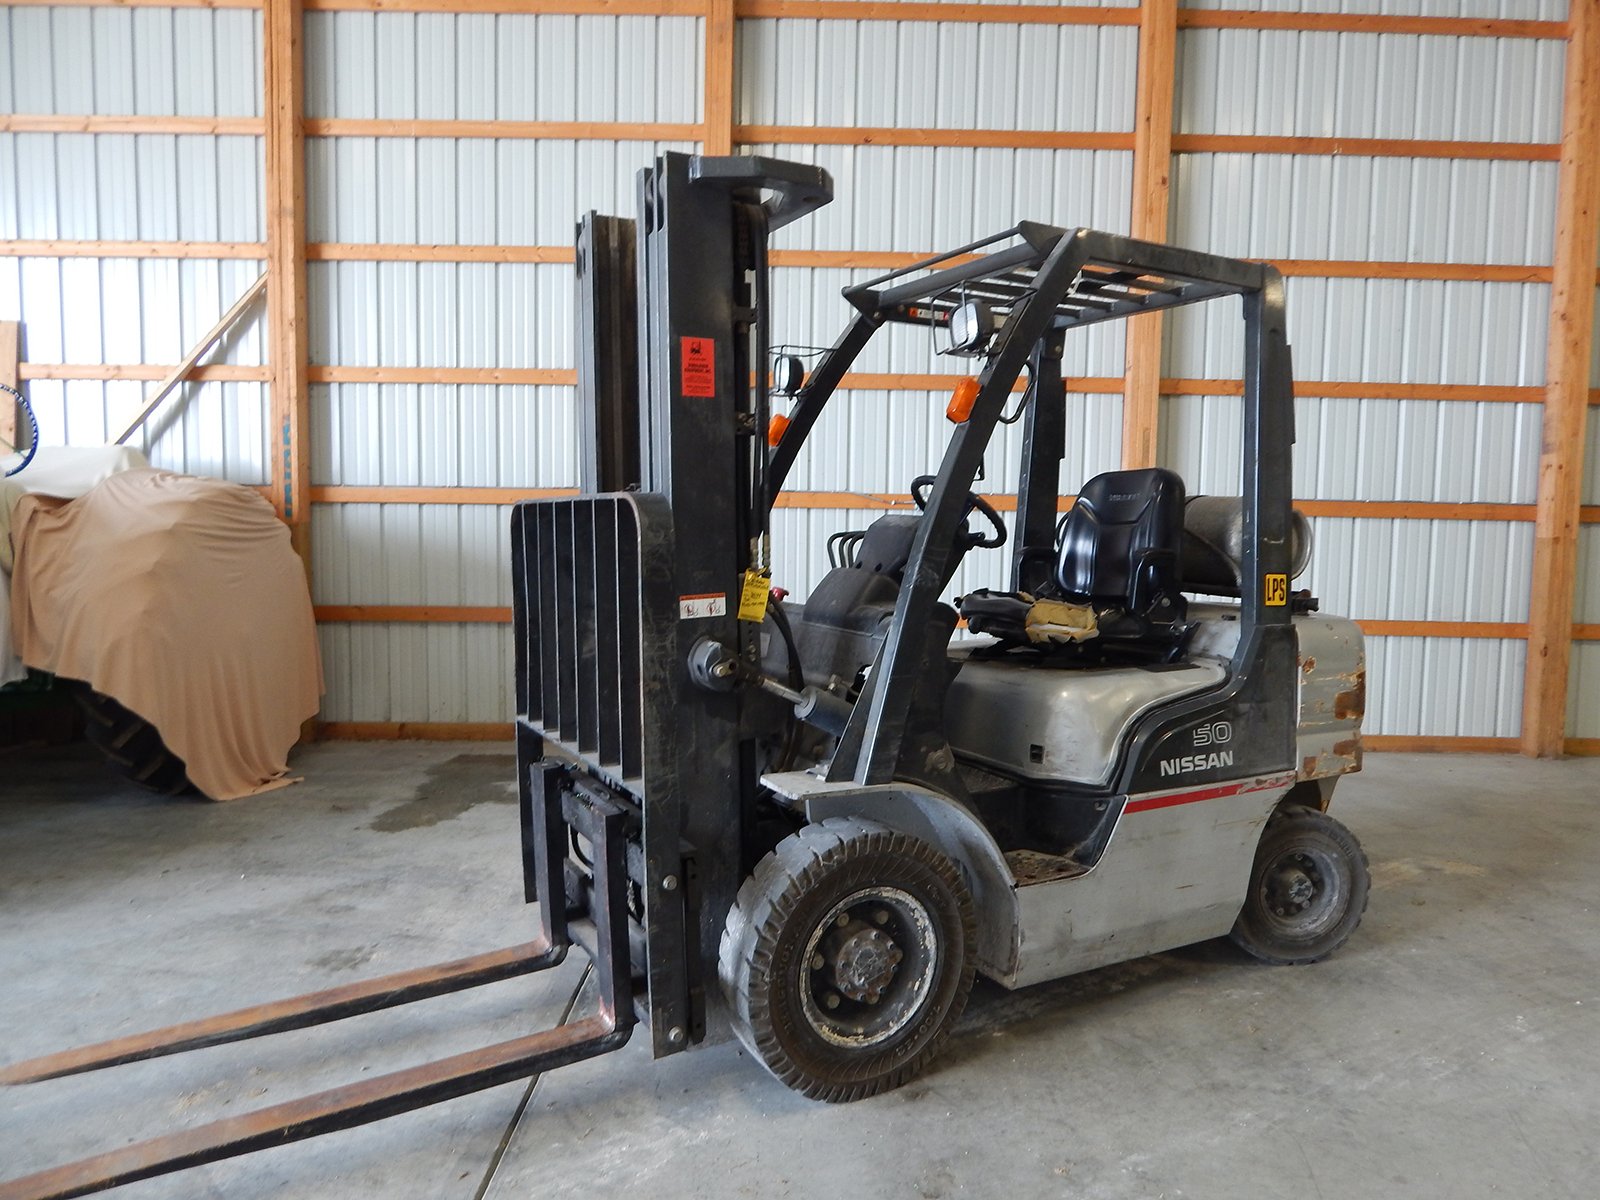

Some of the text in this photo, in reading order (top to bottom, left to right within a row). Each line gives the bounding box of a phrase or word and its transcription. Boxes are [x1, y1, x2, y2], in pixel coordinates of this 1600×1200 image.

[1267, 578, 1285, 602] LPS
[1193, 721, 1232, 747] 50
[1160, 750, 1234, 777] NISSAN
